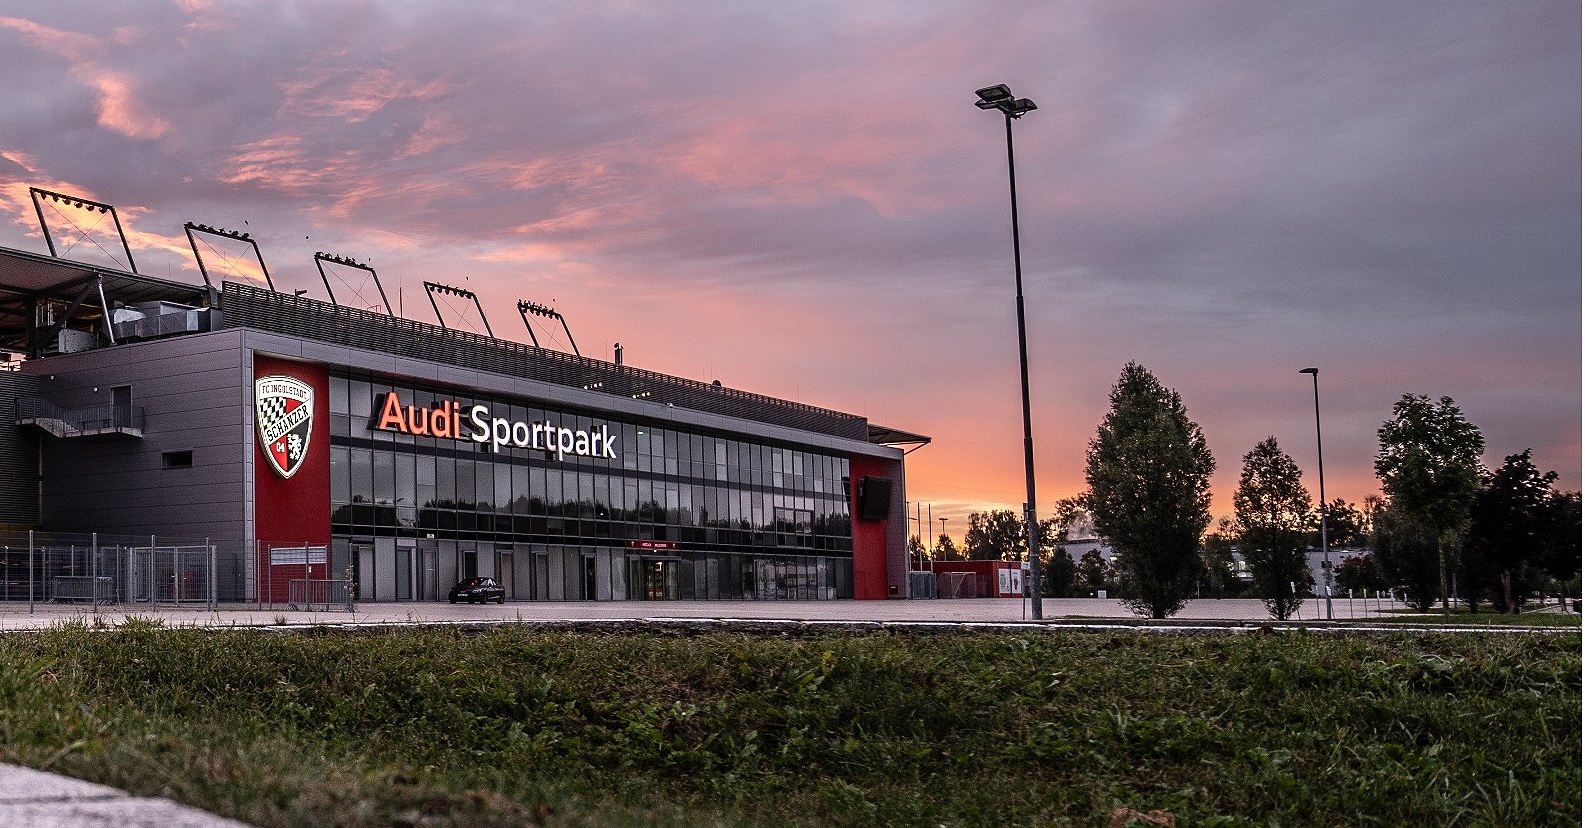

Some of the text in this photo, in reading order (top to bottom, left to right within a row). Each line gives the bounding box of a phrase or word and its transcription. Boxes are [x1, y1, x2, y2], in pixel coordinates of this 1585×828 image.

[271, 384, 307, 400] INGOLSTADT
[267, 404, 309, 442] SCHANZER
[378, 391, 617, 462] Audi Sportpark
[276, 442, 285, 453] 04
